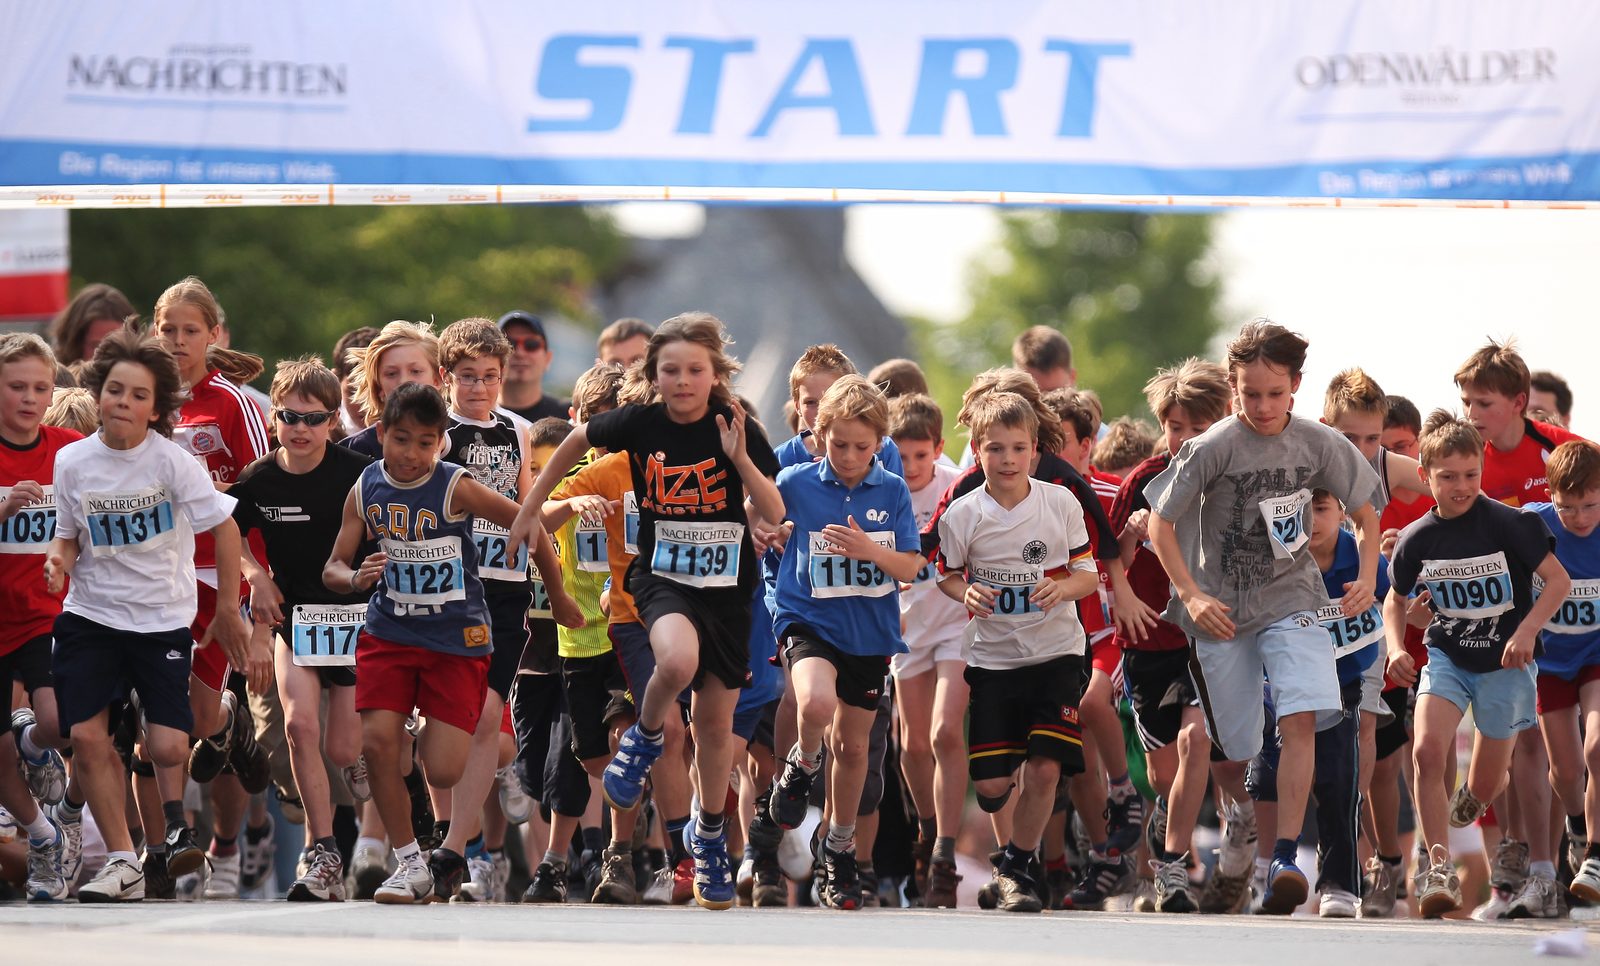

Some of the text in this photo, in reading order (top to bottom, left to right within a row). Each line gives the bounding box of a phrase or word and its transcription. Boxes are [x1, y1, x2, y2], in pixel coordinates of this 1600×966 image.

[67, 54, 347, 95] NACHRICHTEN
[1295, 46, 1557, 89] ODENWÄLDER
[526, 32, 1133, 138] START
[1225, 466, 1311, 497] YALE
[88, 488, 166, 511] NACHRICHTEN
[642, 497, 728, 515] MEISTER
[1, 510, 57, 543] 1037
[100, 506, 161, 545] 1131
[661, 527, 738, 541] NACHRICHTEN
[384, 543, 456, 559] NACHRICHTEN
[668, 544, 729, 577] 1139
[391, 562, 454, 594] 1122
[1425, 560, 1502, 578] NACHRICHTEN
[1436, 577, 1503, 609] 1090
[299, 612, 367, 623] NACHRICHTE
[1329, 609, 1376, 648] 158
[1459, 639, 1491, 648] OTTAWA
